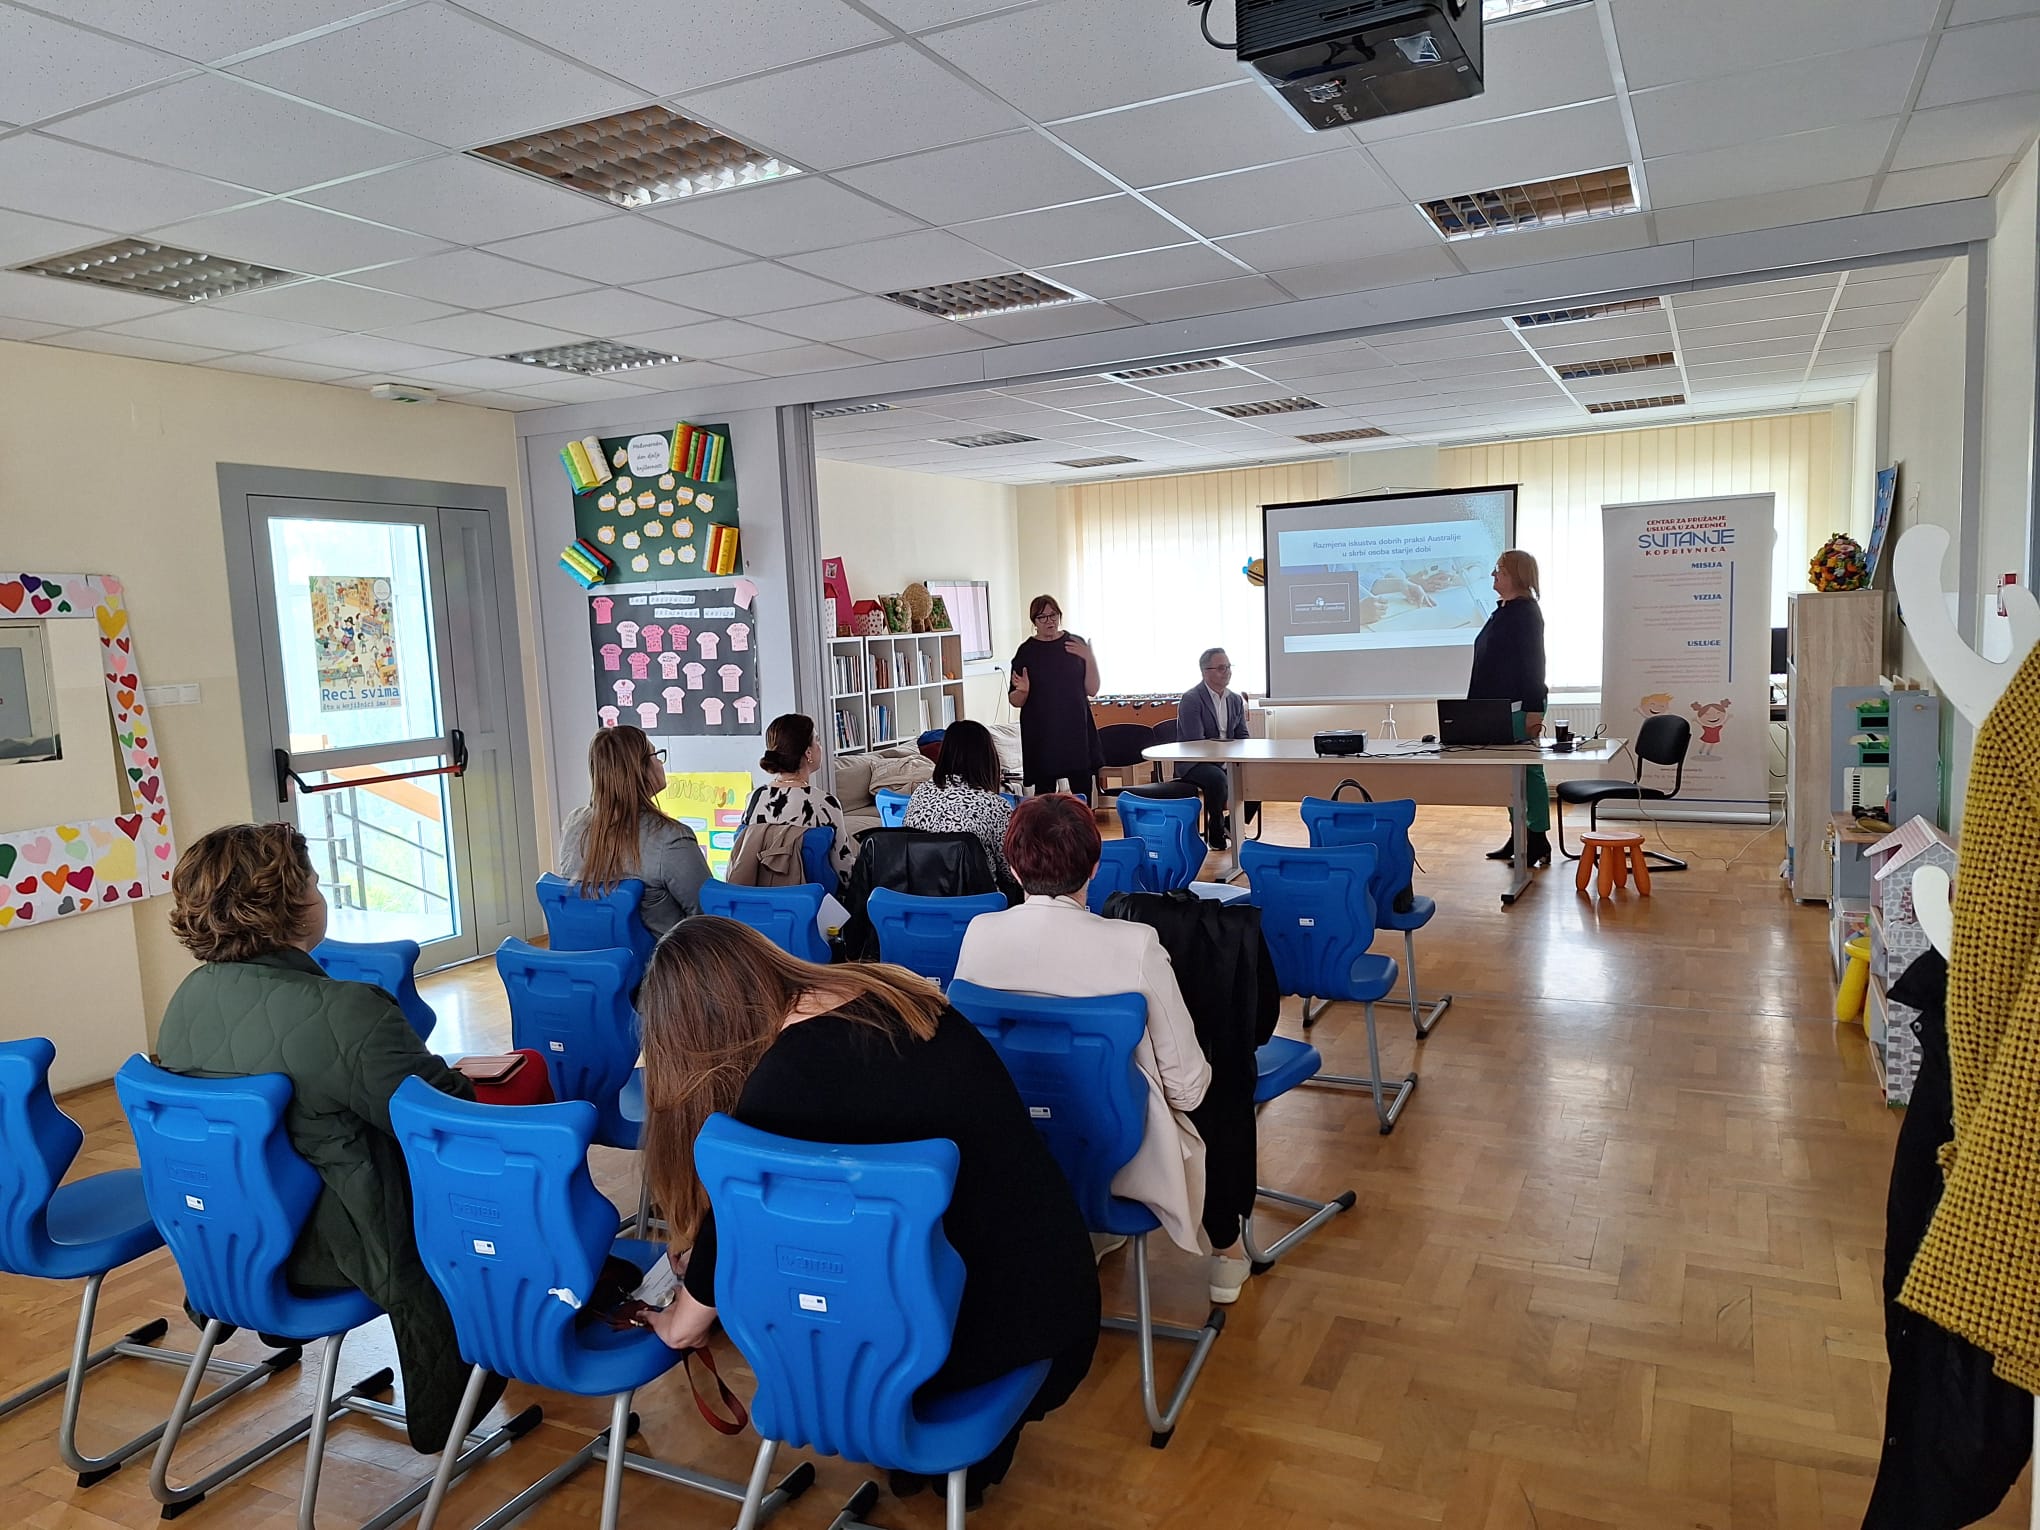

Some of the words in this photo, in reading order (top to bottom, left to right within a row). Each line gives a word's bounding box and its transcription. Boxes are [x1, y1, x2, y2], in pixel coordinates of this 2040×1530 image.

[1647, 518, 1675, 526] CENTAR
[1685, 522, 1727, 530] ZAJEDNICI
[1313, 541, 1346, 550] Razmjena
[1348, 538, 1377, 547] iskustva
[1378, 537, 1402, 545] dobrih
[1403, 535, 1426, 545] praksi
[1427, 533, 1461, 543] Australije
[1349, 549, 1366, 557] skrbi
[1368, 548, 1390, 556] osoba
[1391, 546, 1413, 556] starije
[1415, 545, 1432, 553] dobi
[1645, 546, 1726, 556] KOPRIVNICA
[322, 687, 356, 701] Reci
[361, 685, 400, 699] svima
